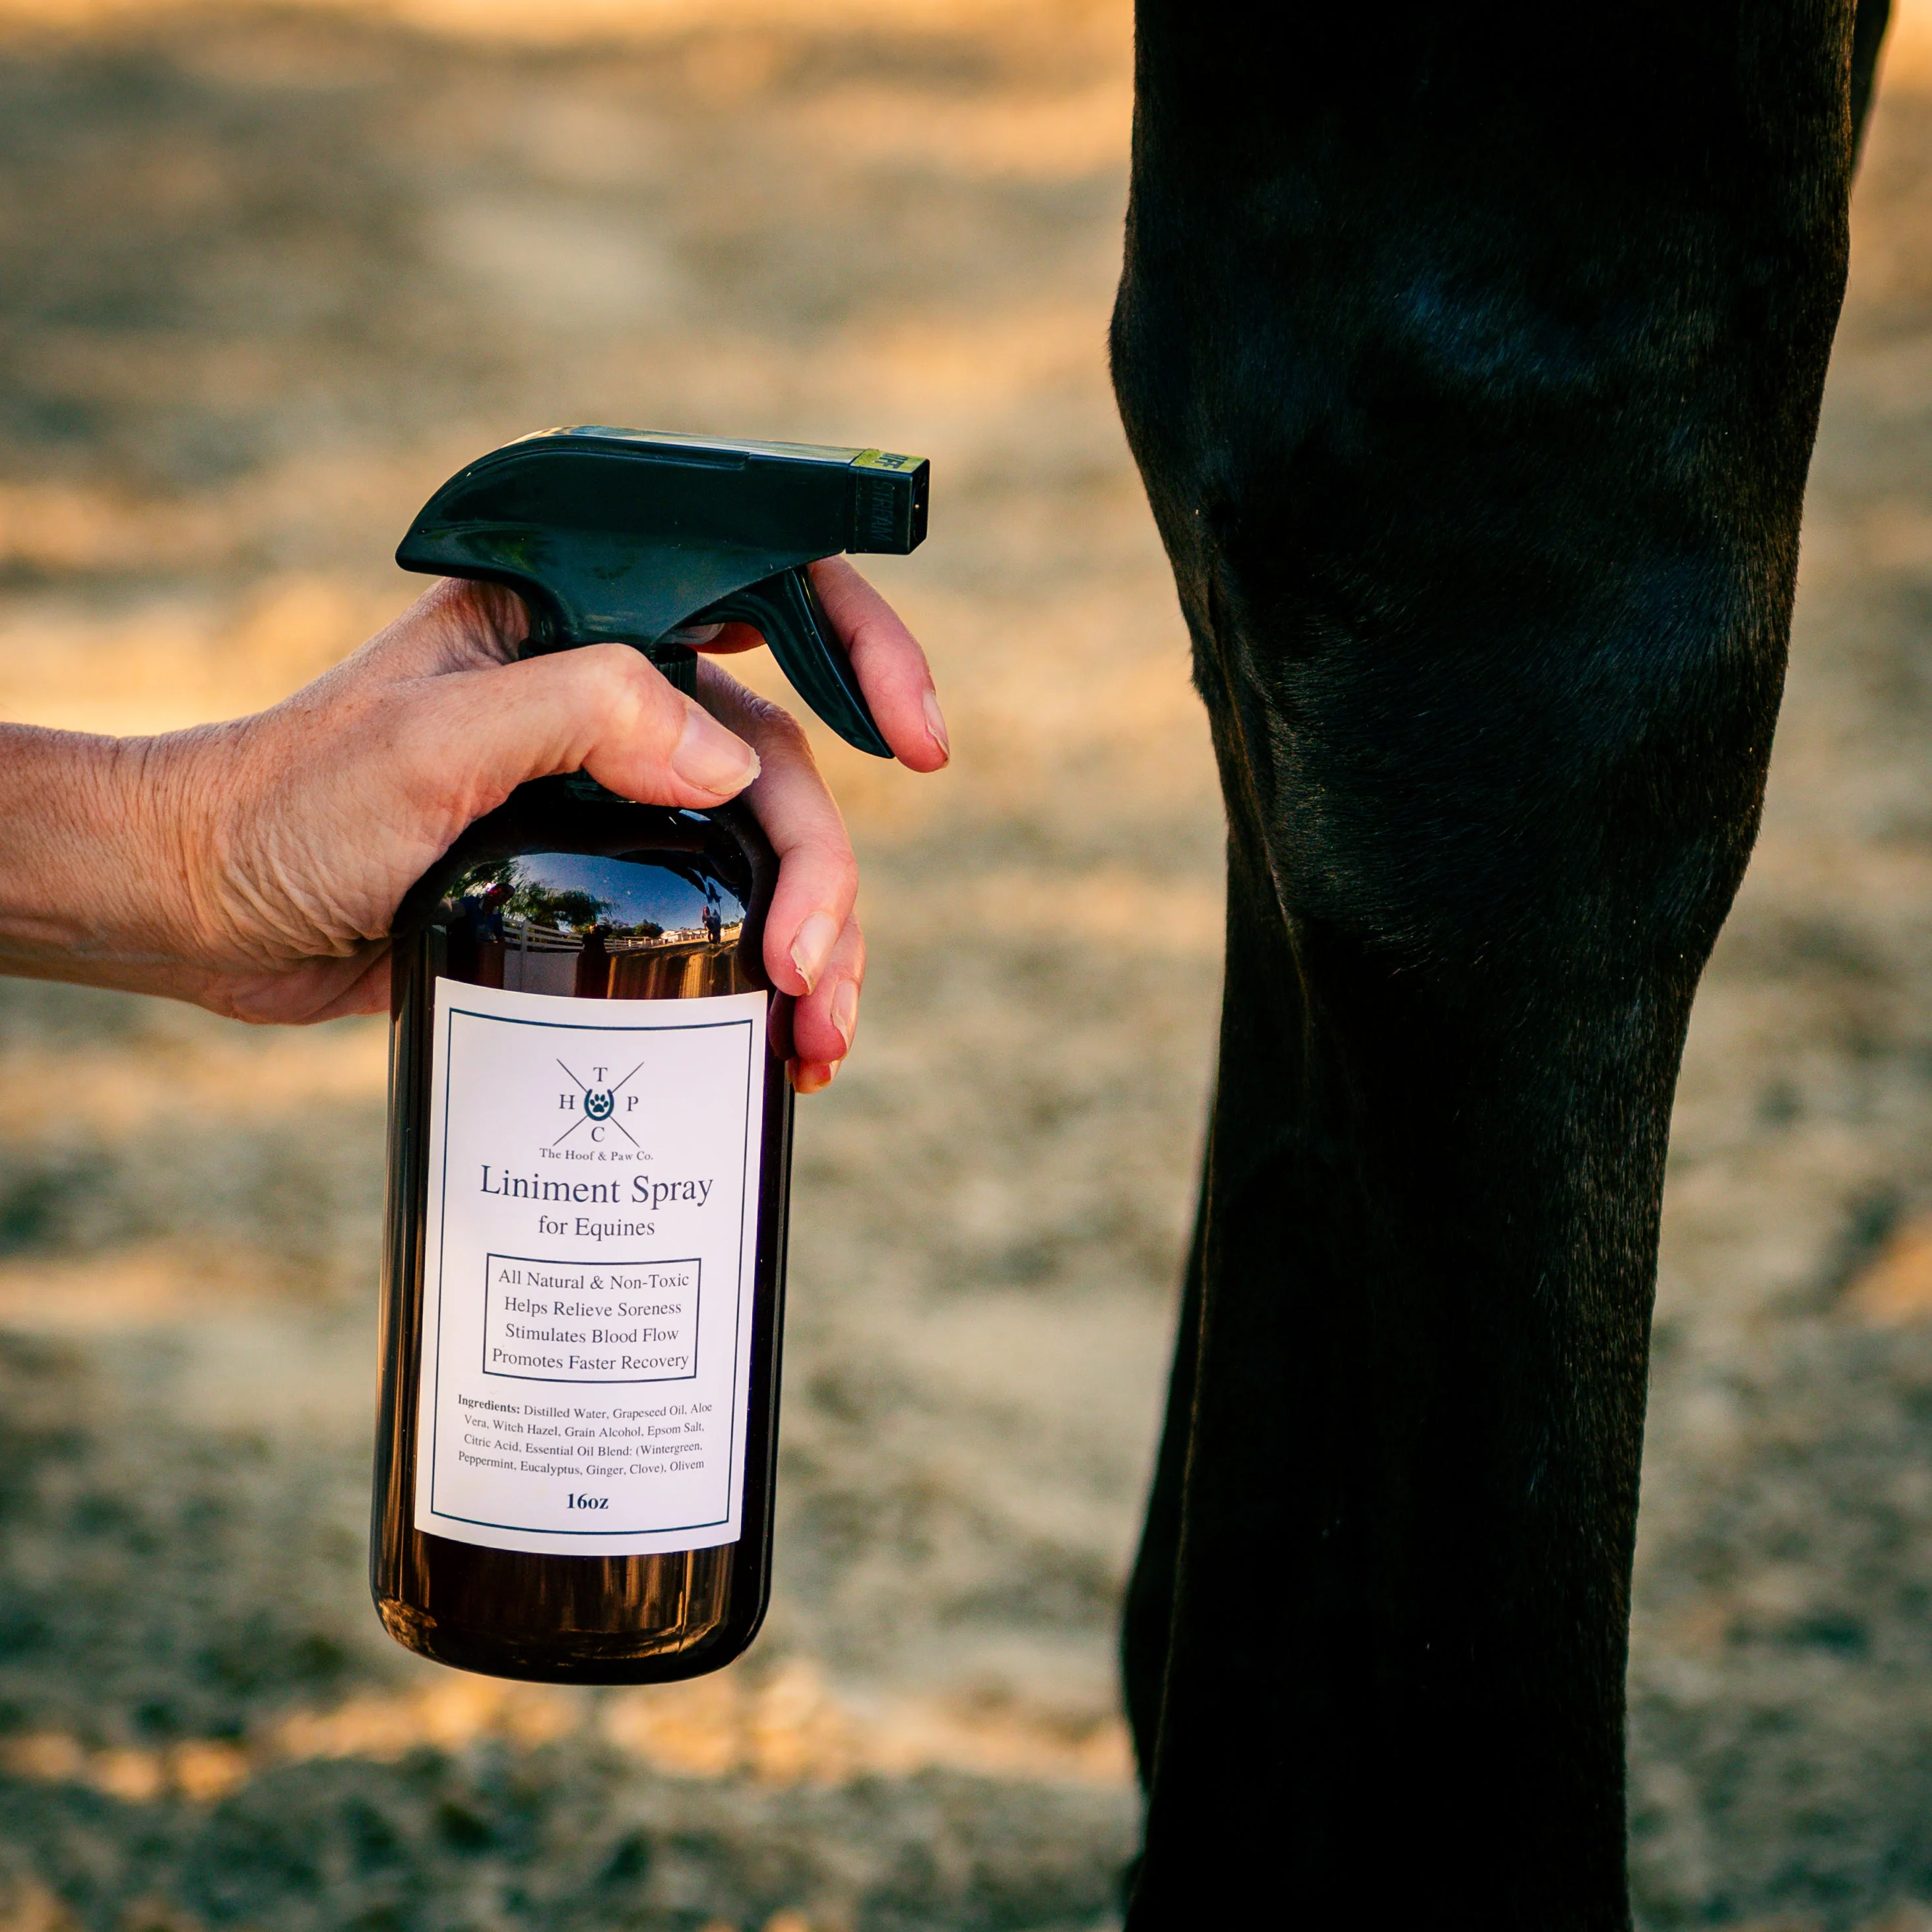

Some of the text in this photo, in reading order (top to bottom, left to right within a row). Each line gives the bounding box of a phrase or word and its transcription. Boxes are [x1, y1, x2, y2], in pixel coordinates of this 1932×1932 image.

[593, 1066, 608, 1083] T
[558, 1093, 576, 1110] H
[626, 1095, 639, 1112] P
[591, 1126, 605, 1143] C
[539, 1147, 653, 1161] The Hoof & Paw Co.
[480, 1164, 714, 1211] Liniment Spray
[538, 1215, 655, 1242] for Equines
[498, 1269, 690, 1290] All Natural & Non-Toxic
[504, 1296, 682, 1318] Helps Relieve Soreness
[505, 1323, 679, 1343] Stimulates Blood Flow
[492, 1347, 689, 1370] Promotes Faster Recovery
[458, 1394, 713, 1421] Ingredients: Distilled Water, Grapeseed Oil, Aloe
[464, 1414, 705, 1438] Vera, Witch Hazel, Grain Alcohol, Epsom Salt,
[464, 1433, 703, 1457] Citric Acid, Essential Oil Blend: (Wintergreen,
[459, 1450, 517, 1471] Peppermint,
[520, 1460, 583, 1477] Eucalyptus,
[586, 1464, 627, 1478] Ginger,
[629, 1464, 667, 1475] Clove),
[566, 1493, 609, 1510] 16oz
